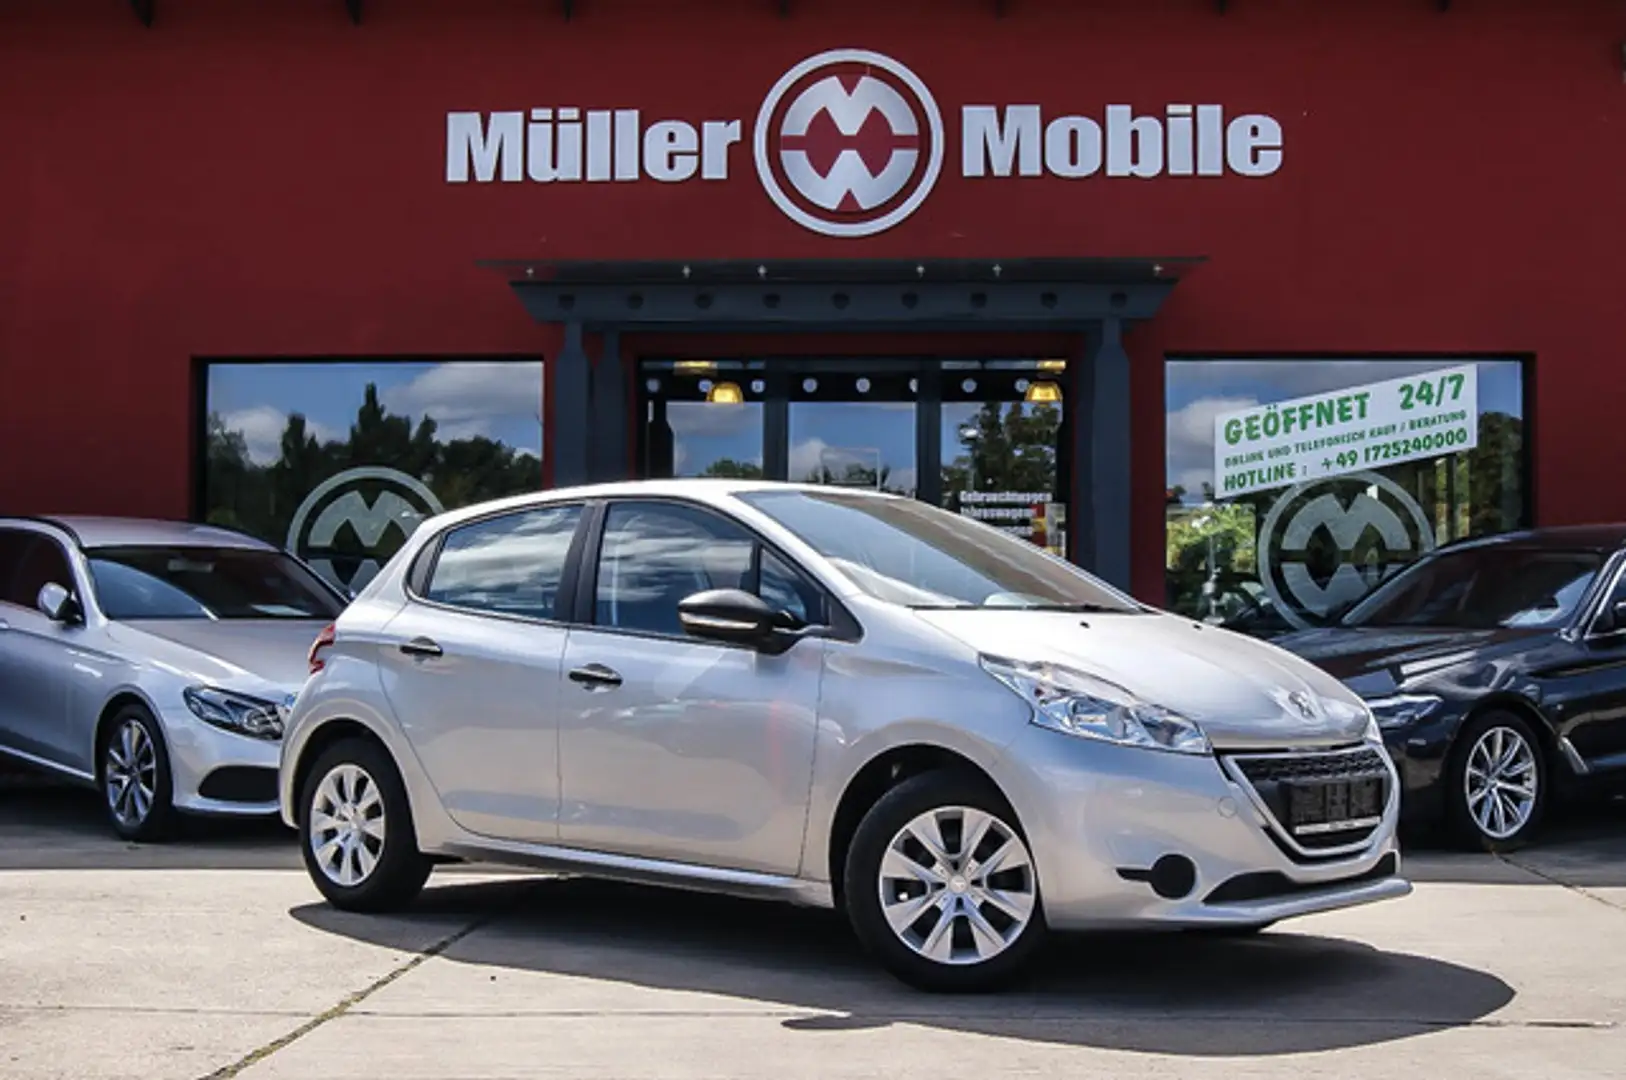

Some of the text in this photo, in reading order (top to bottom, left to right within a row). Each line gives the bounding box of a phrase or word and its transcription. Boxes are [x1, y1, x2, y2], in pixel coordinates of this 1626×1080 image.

[446, 107, 741, 182] Müller
[962, 104, 1283, 177] Mobile
[1224, 451, 1264, 468] ONLINE
[1268, 445, 1292, 459] UND
[1409, 410, 1467, 430] BERATUNG
[1225, 374, 1464, 445] GEÖFFNET 24/7
[1224, 462, 1296, 491] HOTLINE
[1322, 450, 1358, 470] +49
[1364, 428, 1468, 463] 1725240000
